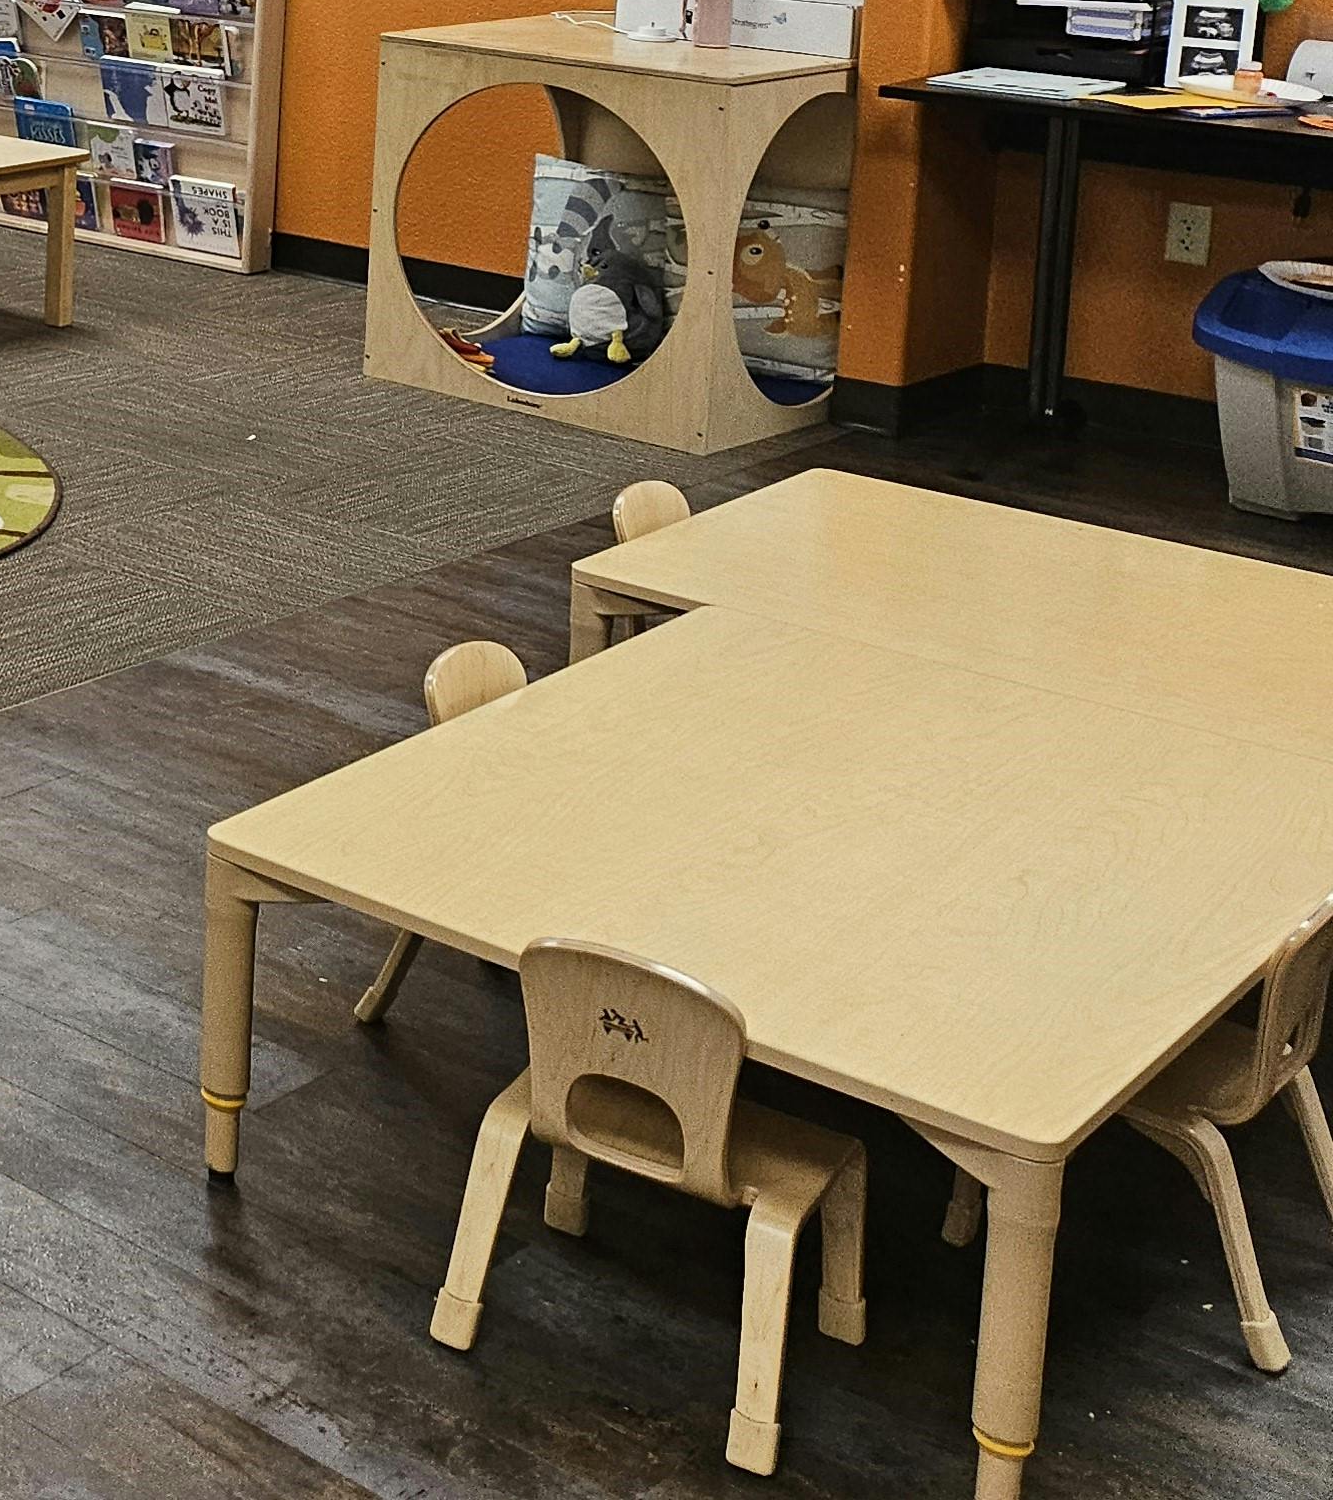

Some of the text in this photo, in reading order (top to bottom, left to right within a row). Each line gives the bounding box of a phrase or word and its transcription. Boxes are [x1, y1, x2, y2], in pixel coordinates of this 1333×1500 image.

[197, 84, 216, 96] Copy
[30, 123, 66, 143] KISSES
[191, 185, 228, 199] SHAPES
[203, 206, 230, 219] BOOK
[213, 217, 232, 228] IS A
[211, 227, 232, 238] THIS
